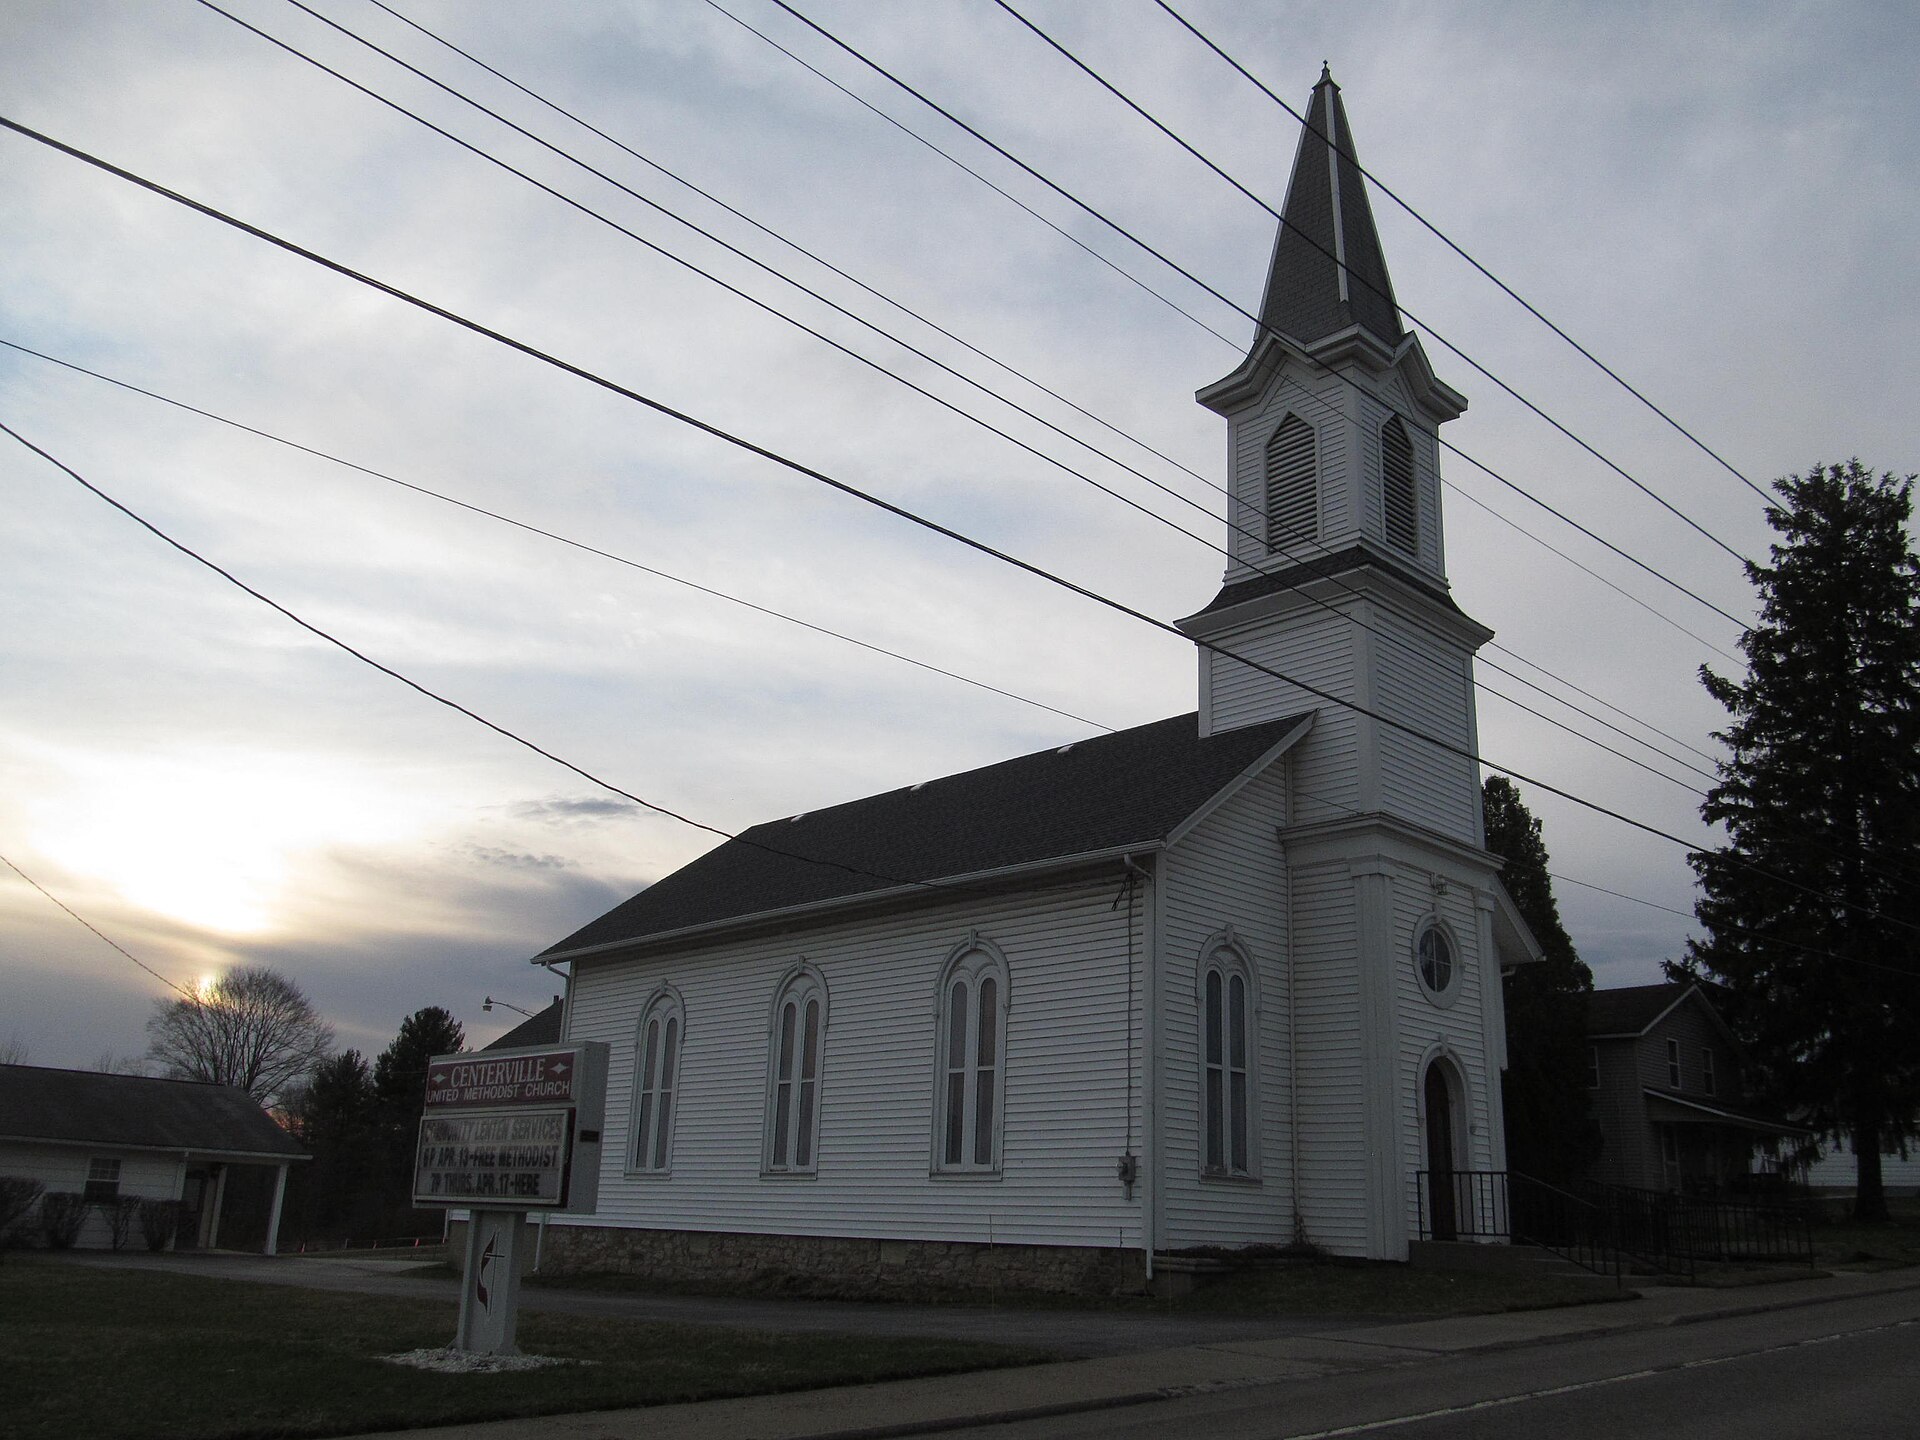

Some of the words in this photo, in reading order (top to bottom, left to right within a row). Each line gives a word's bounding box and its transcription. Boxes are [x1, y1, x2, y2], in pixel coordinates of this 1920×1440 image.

[451, 1058, 545, 1087] CENTERVILLE
[427, 1089, 459, 1102] UNITED
[463, 1084, 519, 1100] METHODIST
[525, 1080, 570, 1097] CHURCH
[511, 1117, 561, 1140] SERVICES
[498, 1145, 558, 1167] METHODIST
